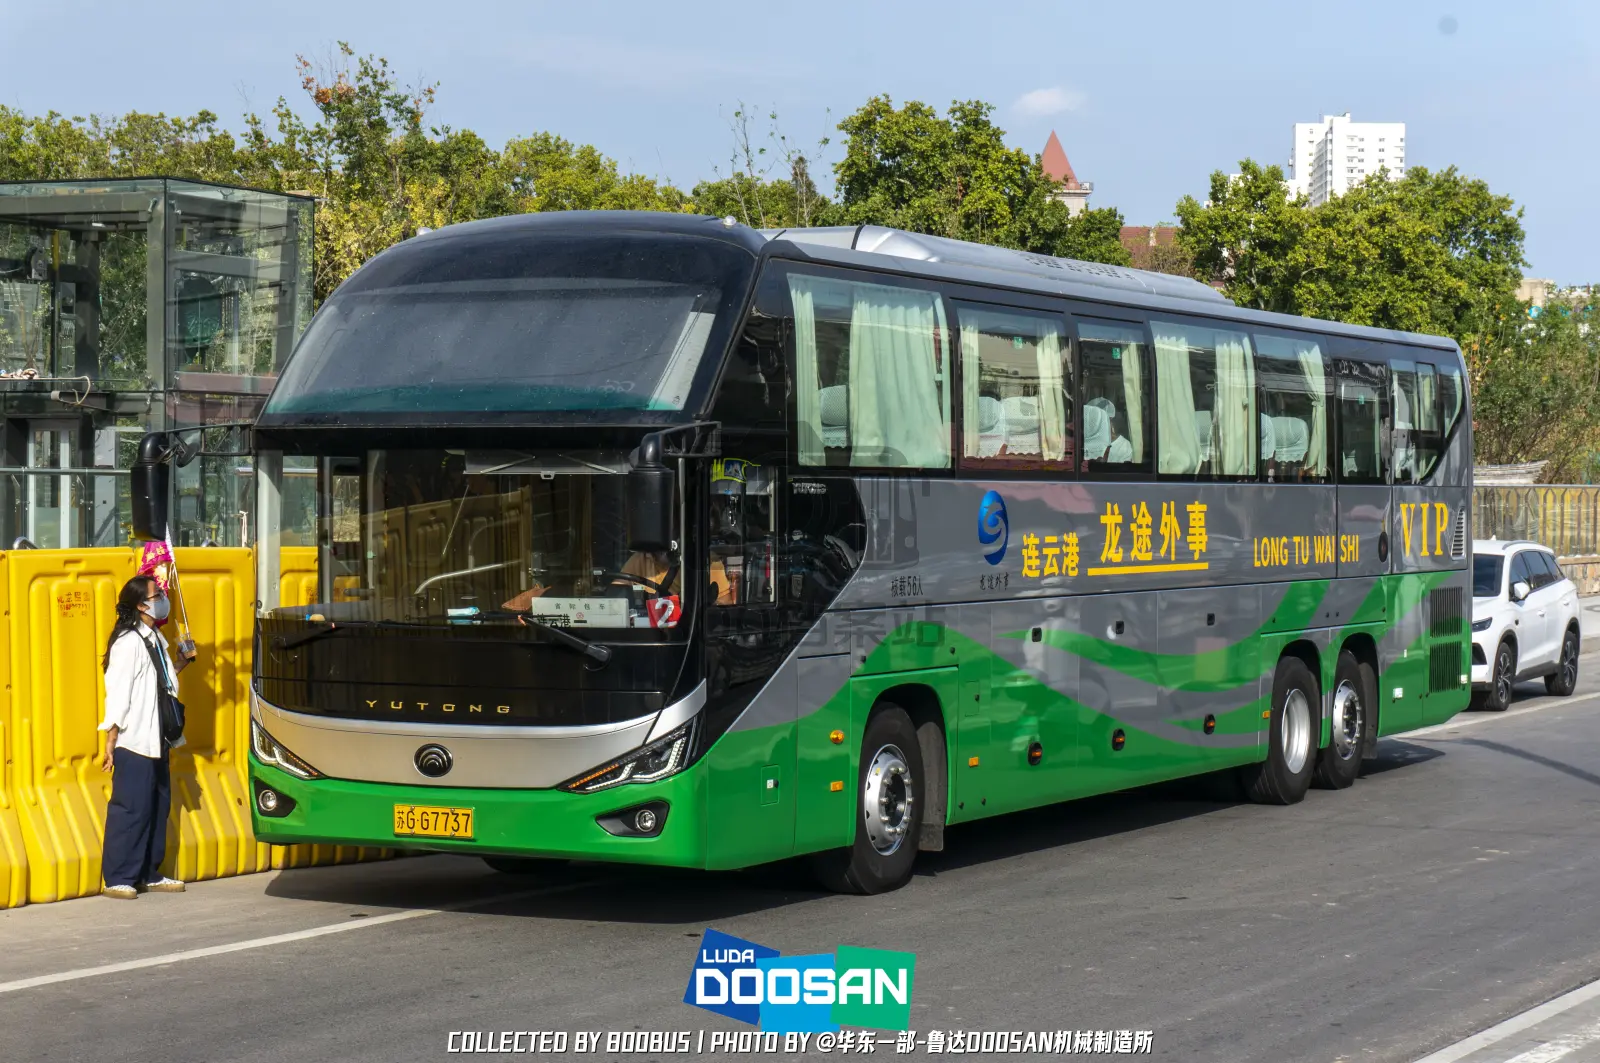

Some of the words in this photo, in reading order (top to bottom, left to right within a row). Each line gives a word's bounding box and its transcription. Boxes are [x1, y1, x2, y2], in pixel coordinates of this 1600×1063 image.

[1021, 531, 1080, 578] 连云港
[1099, 500, 1209, 563] 龙途外事
[1399, 502, 1450, 558] VIP
[1253, 536, 1289, 568] LONG
[1292, 536, 1310, 565] TU
[1313, 535, 1336, 564] WAI
[1339, 534, 1360, 563] SHI
[890, 575, 924, 597] 核载56人
[655, 598, 678, 629] 2
[365, 700, 511, 714] YUTONG
